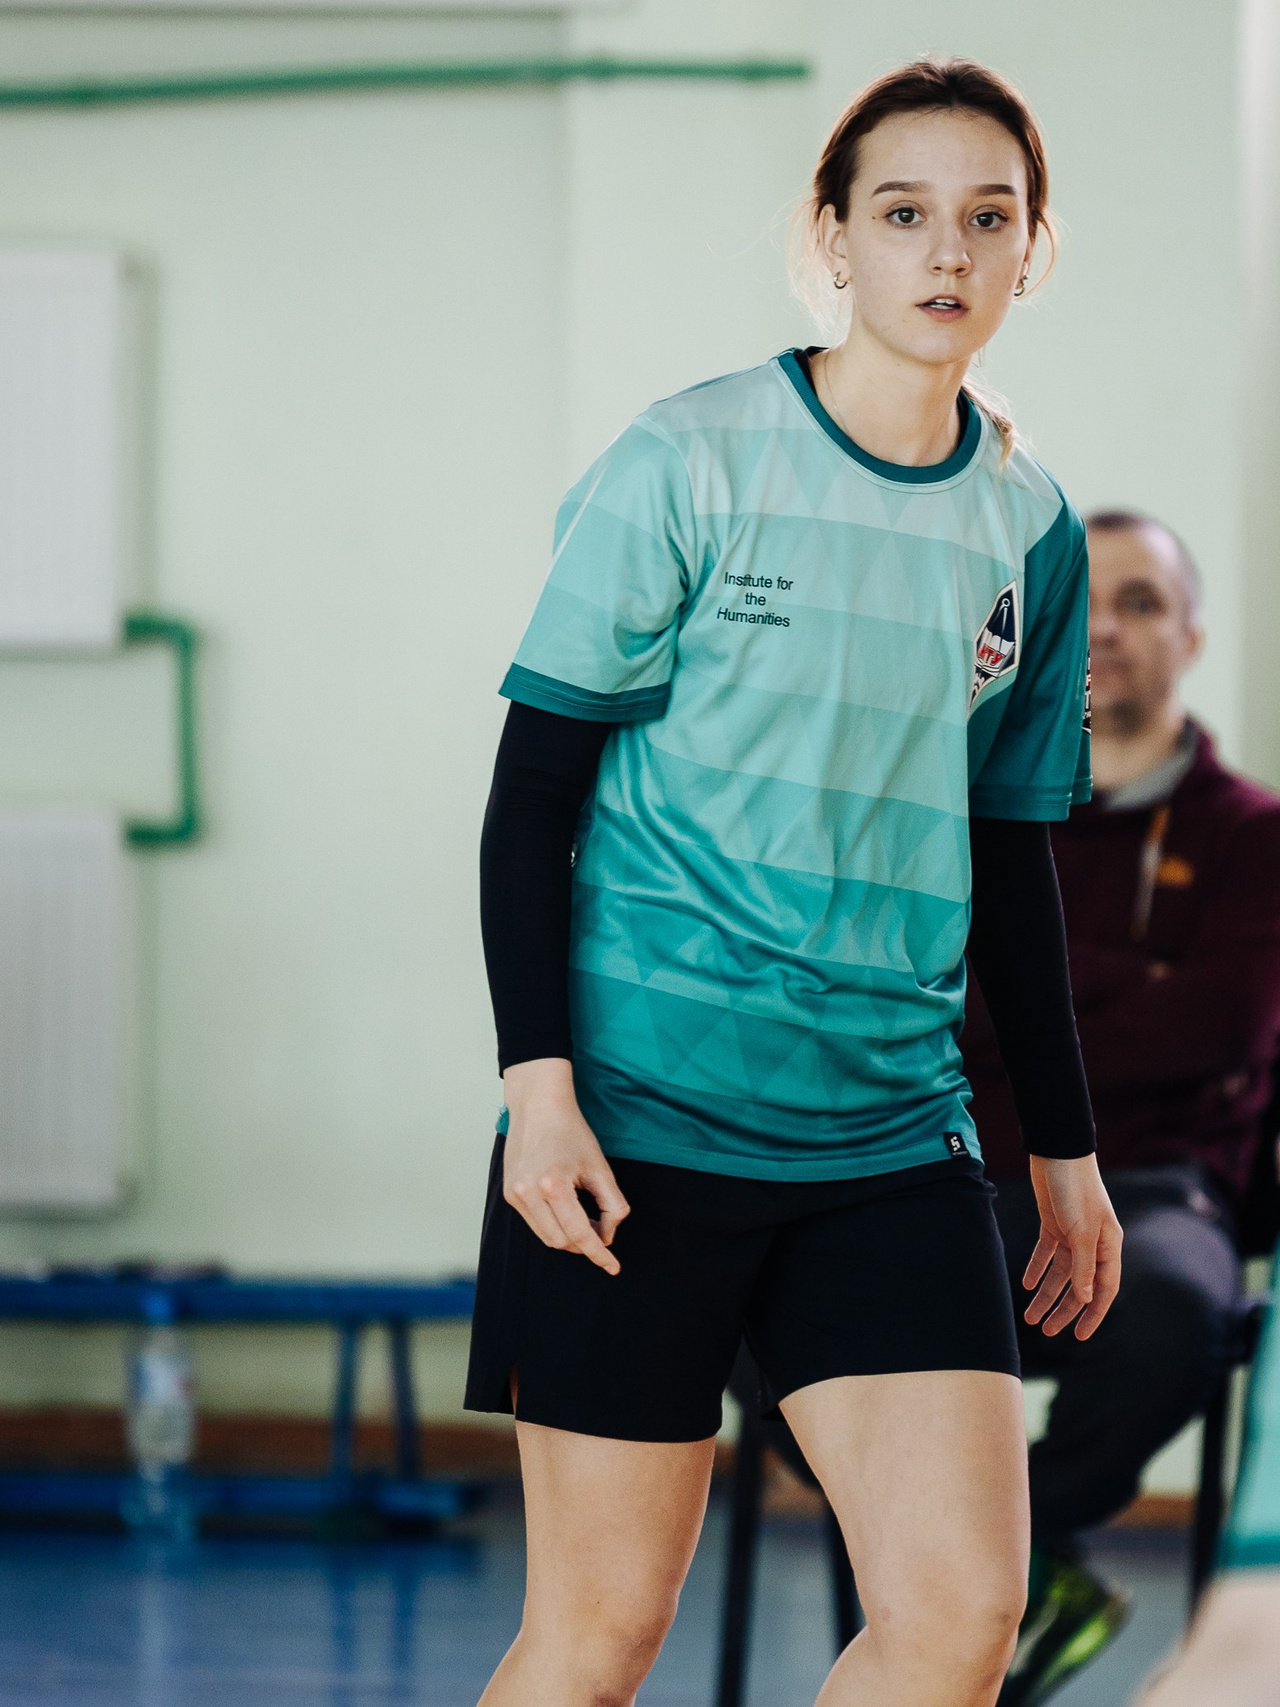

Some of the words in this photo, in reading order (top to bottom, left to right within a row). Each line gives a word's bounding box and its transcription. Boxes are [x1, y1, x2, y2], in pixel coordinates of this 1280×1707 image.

[776, 576, 794, 591] for
[745, 592, 766, 606] the
[716, 606, 790, 627] Humanities
